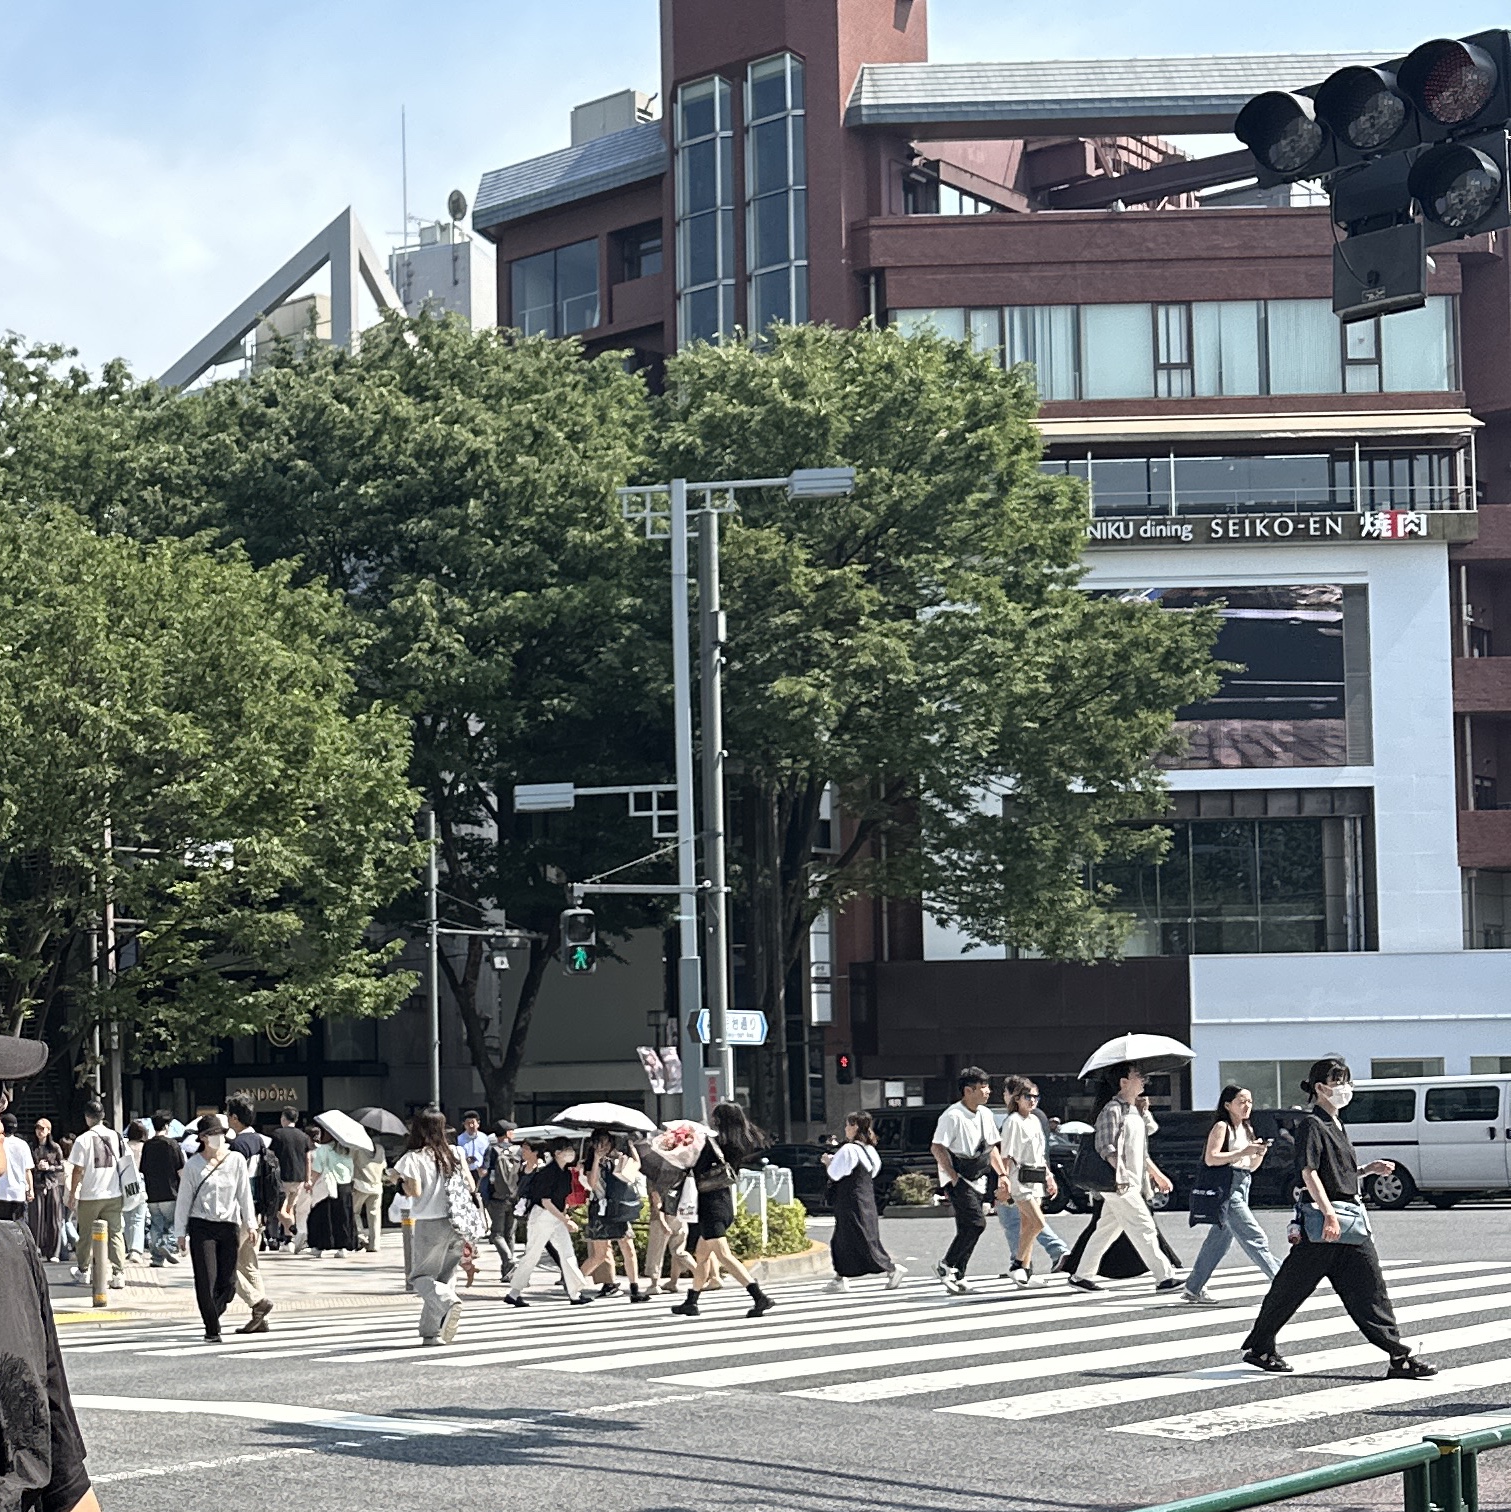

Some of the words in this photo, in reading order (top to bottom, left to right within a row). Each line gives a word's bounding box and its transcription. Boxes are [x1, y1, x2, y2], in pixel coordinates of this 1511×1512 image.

[1139, 519, 1194, 542] dining
[1210, 516, 1343, 538] SEIKO-EN
[1359, 510, 1428, 538] 焼肉
